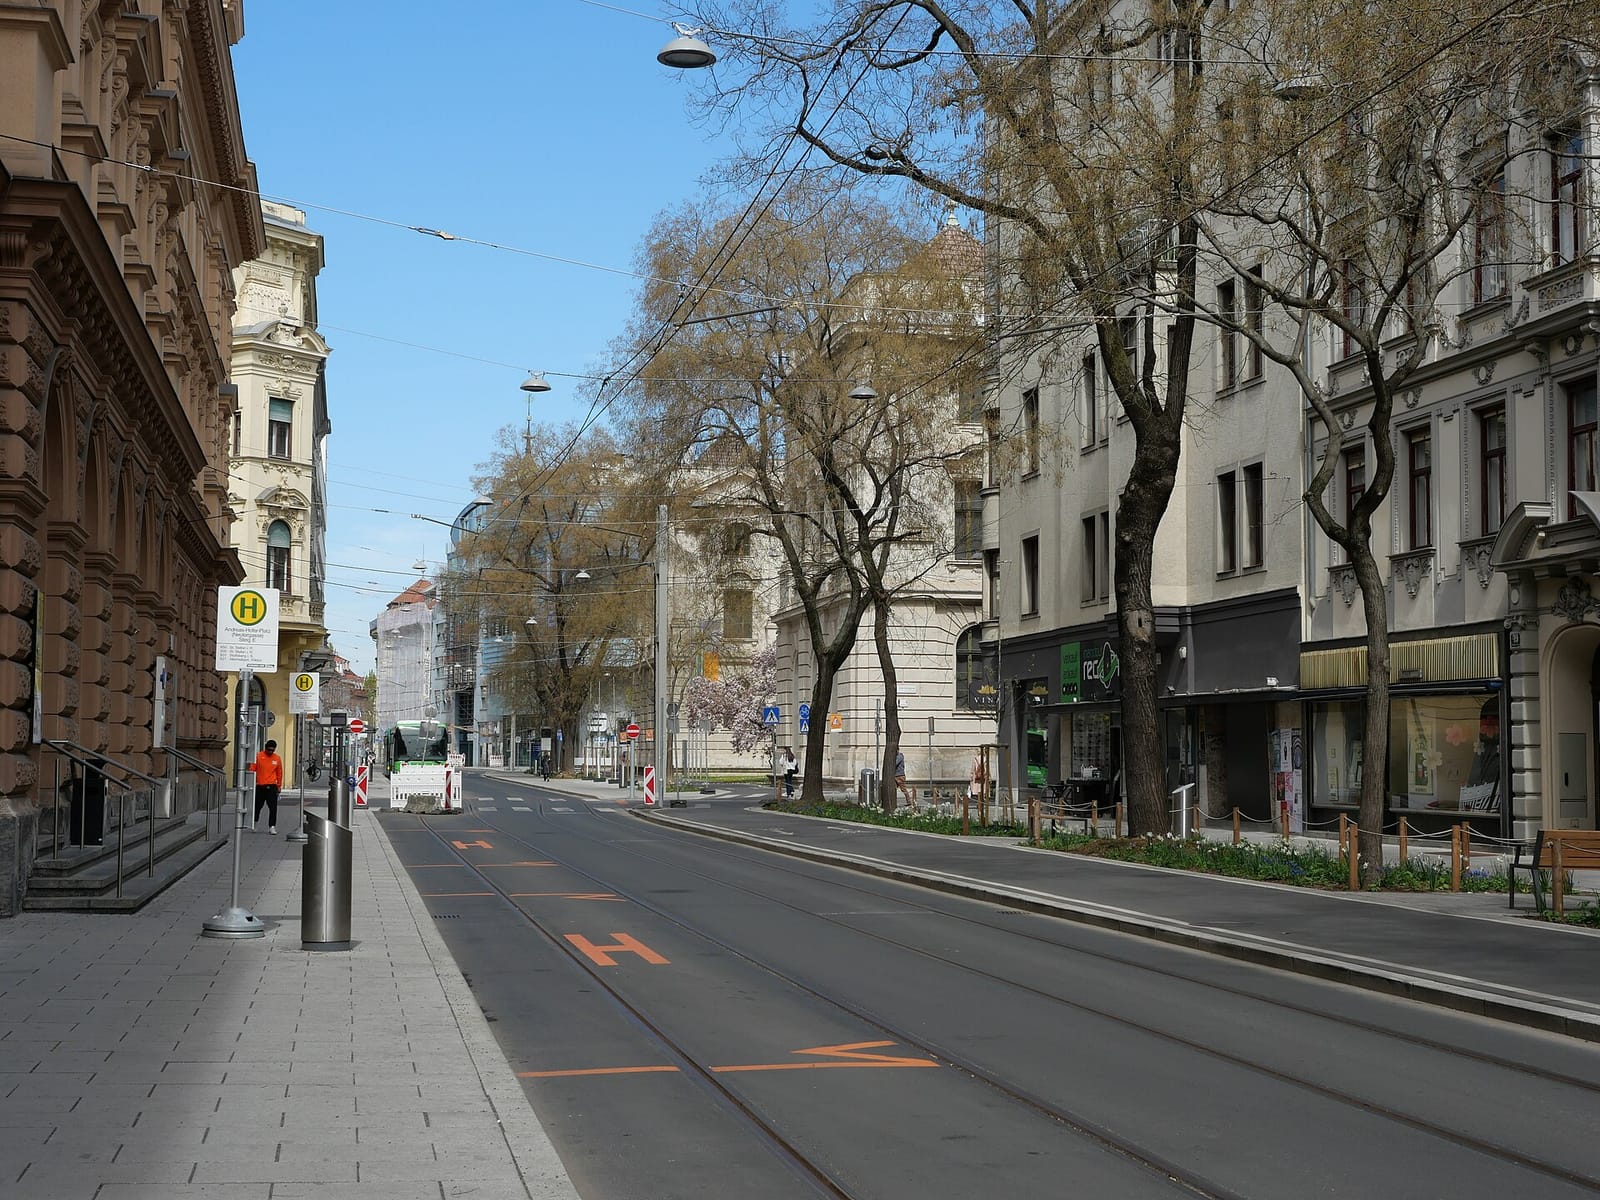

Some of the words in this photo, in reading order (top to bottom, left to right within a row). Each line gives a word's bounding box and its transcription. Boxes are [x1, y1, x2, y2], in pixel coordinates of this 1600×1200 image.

[240, 598, 257, 618] H
[300, 677, 308, 688] H
[563, 933, 671, 966] H
